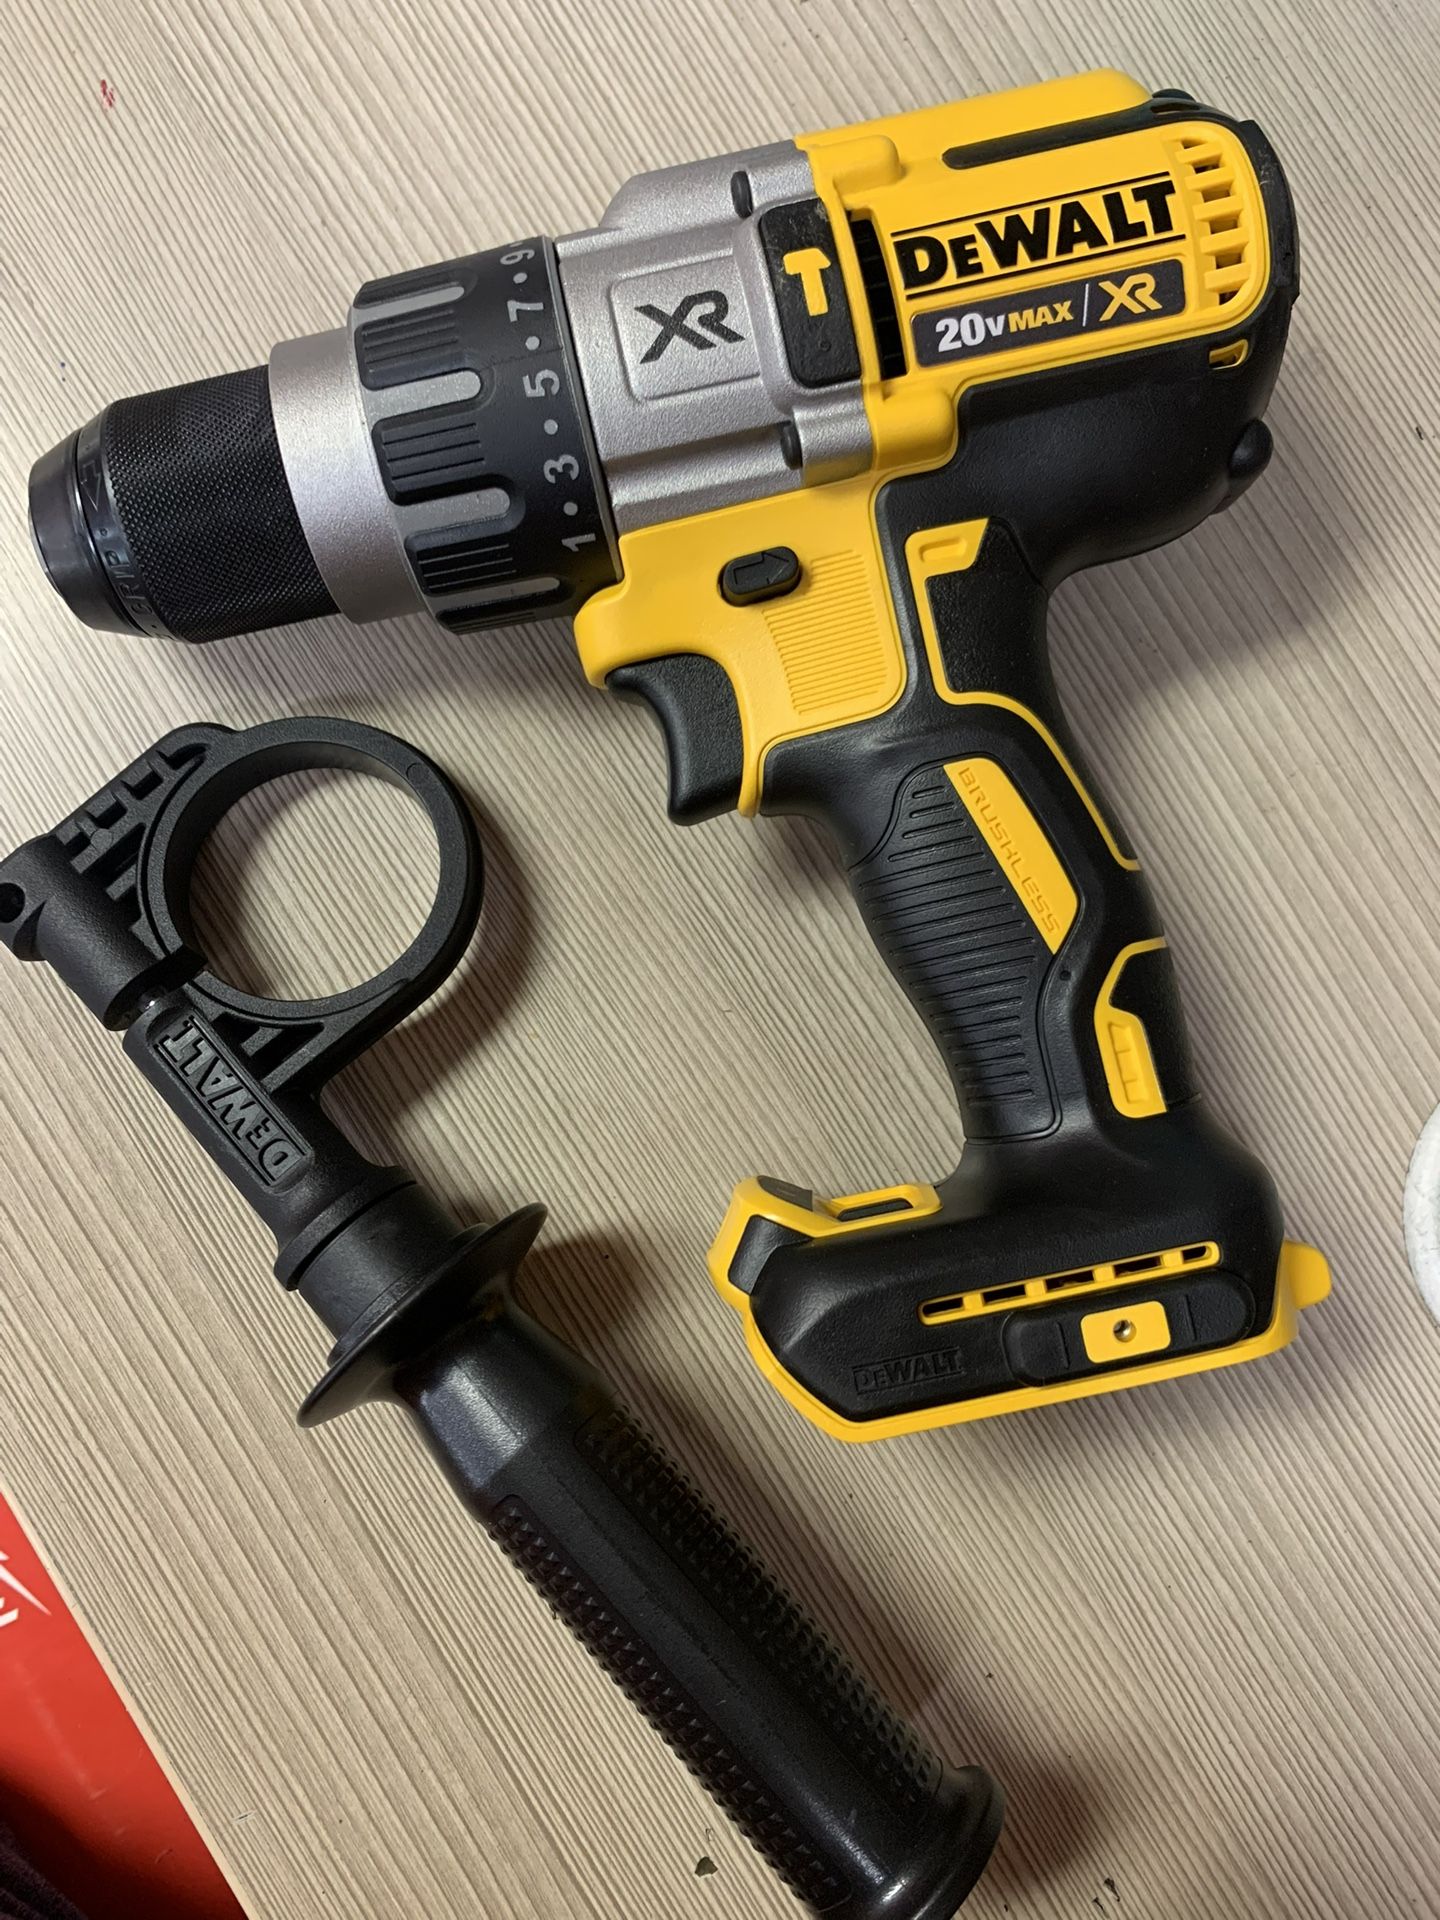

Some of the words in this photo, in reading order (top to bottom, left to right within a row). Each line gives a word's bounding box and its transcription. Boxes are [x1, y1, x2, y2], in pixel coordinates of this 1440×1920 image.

[500, 249, 535, 265] 9
[507, 300, 544, 322] 7
[1098, 272, 1163, 322] XR
[634, 290, 745, 364] XR
[522, 368, 560, 398] 5
[543, 454, 580, 484] 3
[561, 533, 596, 552] 1
[958, 767, 1061, 933] BRUSHLESS
